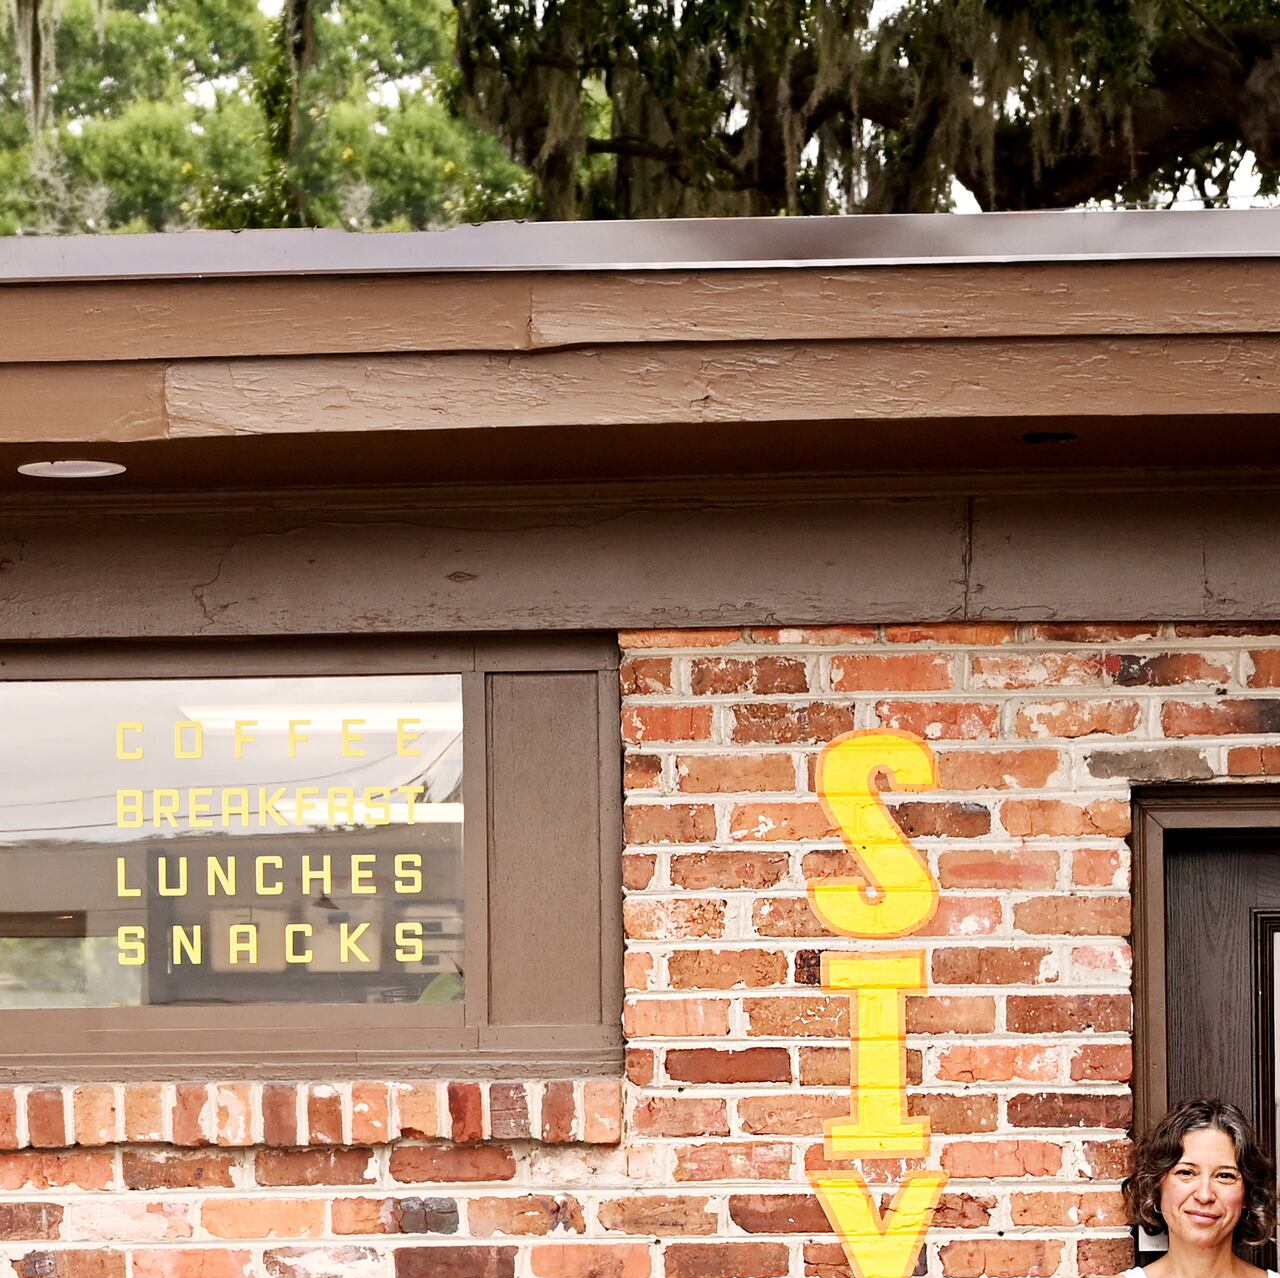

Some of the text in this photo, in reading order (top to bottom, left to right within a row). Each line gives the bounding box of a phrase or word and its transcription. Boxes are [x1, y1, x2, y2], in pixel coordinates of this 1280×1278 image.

[116, 718, 422, 760] COFFEE
[116, 786, 424, 828] BREAKFAST
[116, 854, 422, 897] LUNCHES
[117, 922, 424, 965] SNACKS
